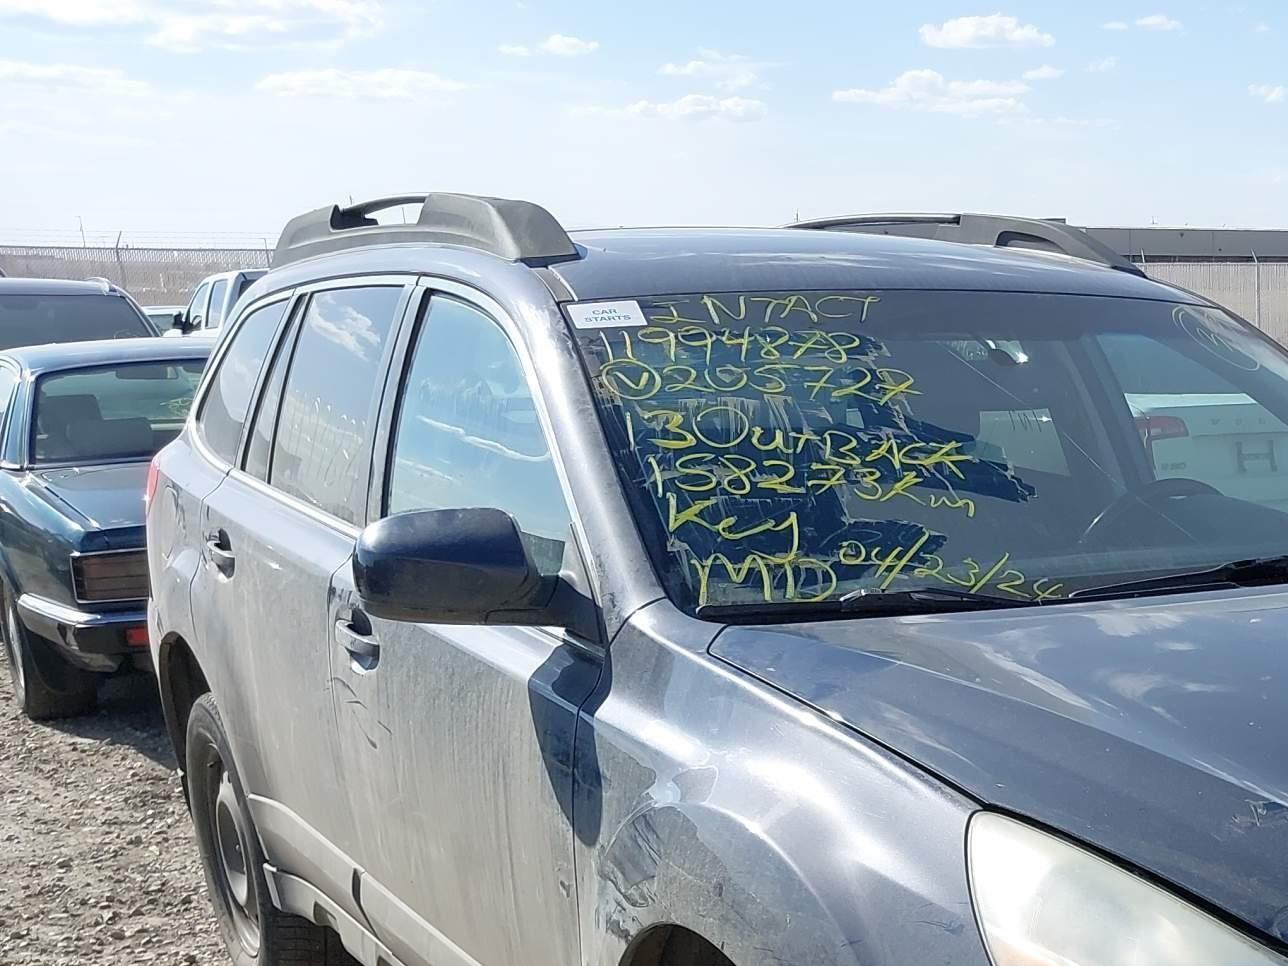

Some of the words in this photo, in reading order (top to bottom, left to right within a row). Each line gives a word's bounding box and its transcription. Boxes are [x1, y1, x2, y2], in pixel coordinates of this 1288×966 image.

[584, 314, 632, 323] STARTS
[649, 295, 881, 325] INTACT
[599, 325, 861, 366] 11994878
